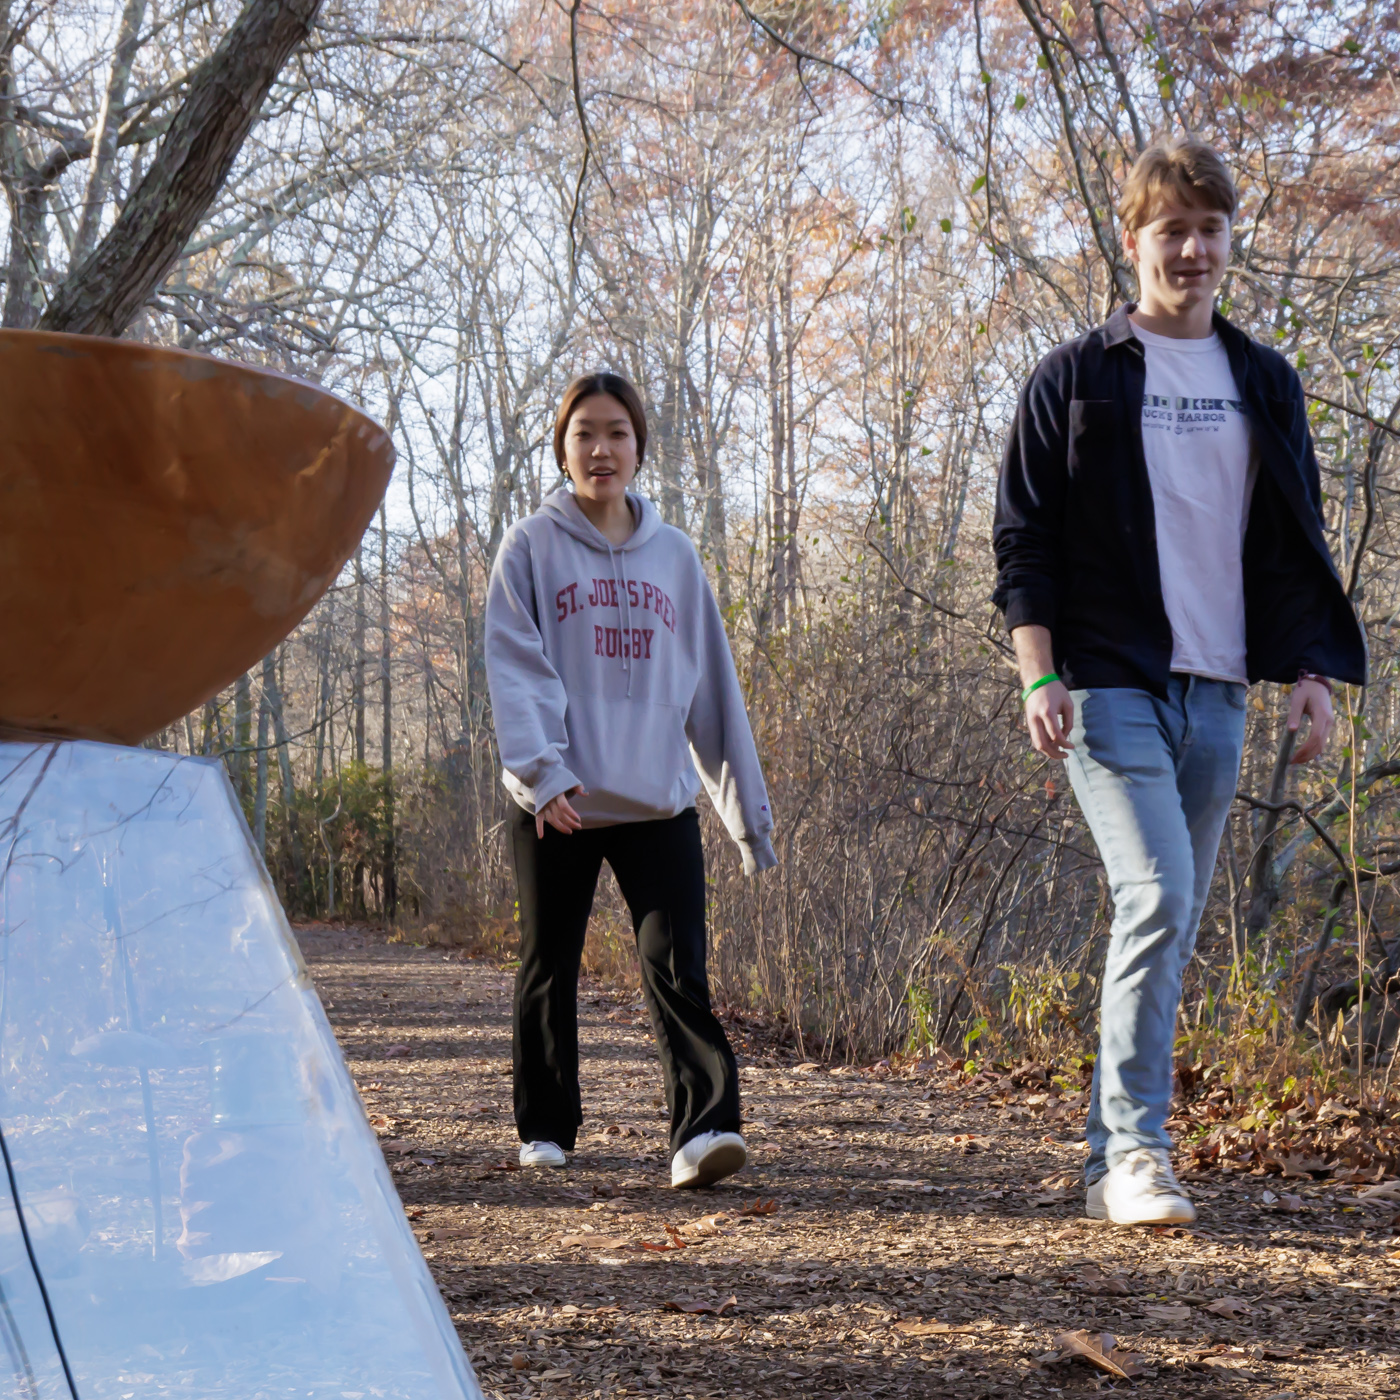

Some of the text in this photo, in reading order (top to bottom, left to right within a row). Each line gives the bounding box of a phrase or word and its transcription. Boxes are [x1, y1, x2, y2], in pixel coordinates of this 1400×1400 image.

[1177, 412, 1226, 422] HARBOR
[556, 582, 584, 622] ST.
[588, 578, 639, 607] JOE'S
[594, 625, 654, 659] RUGBY
